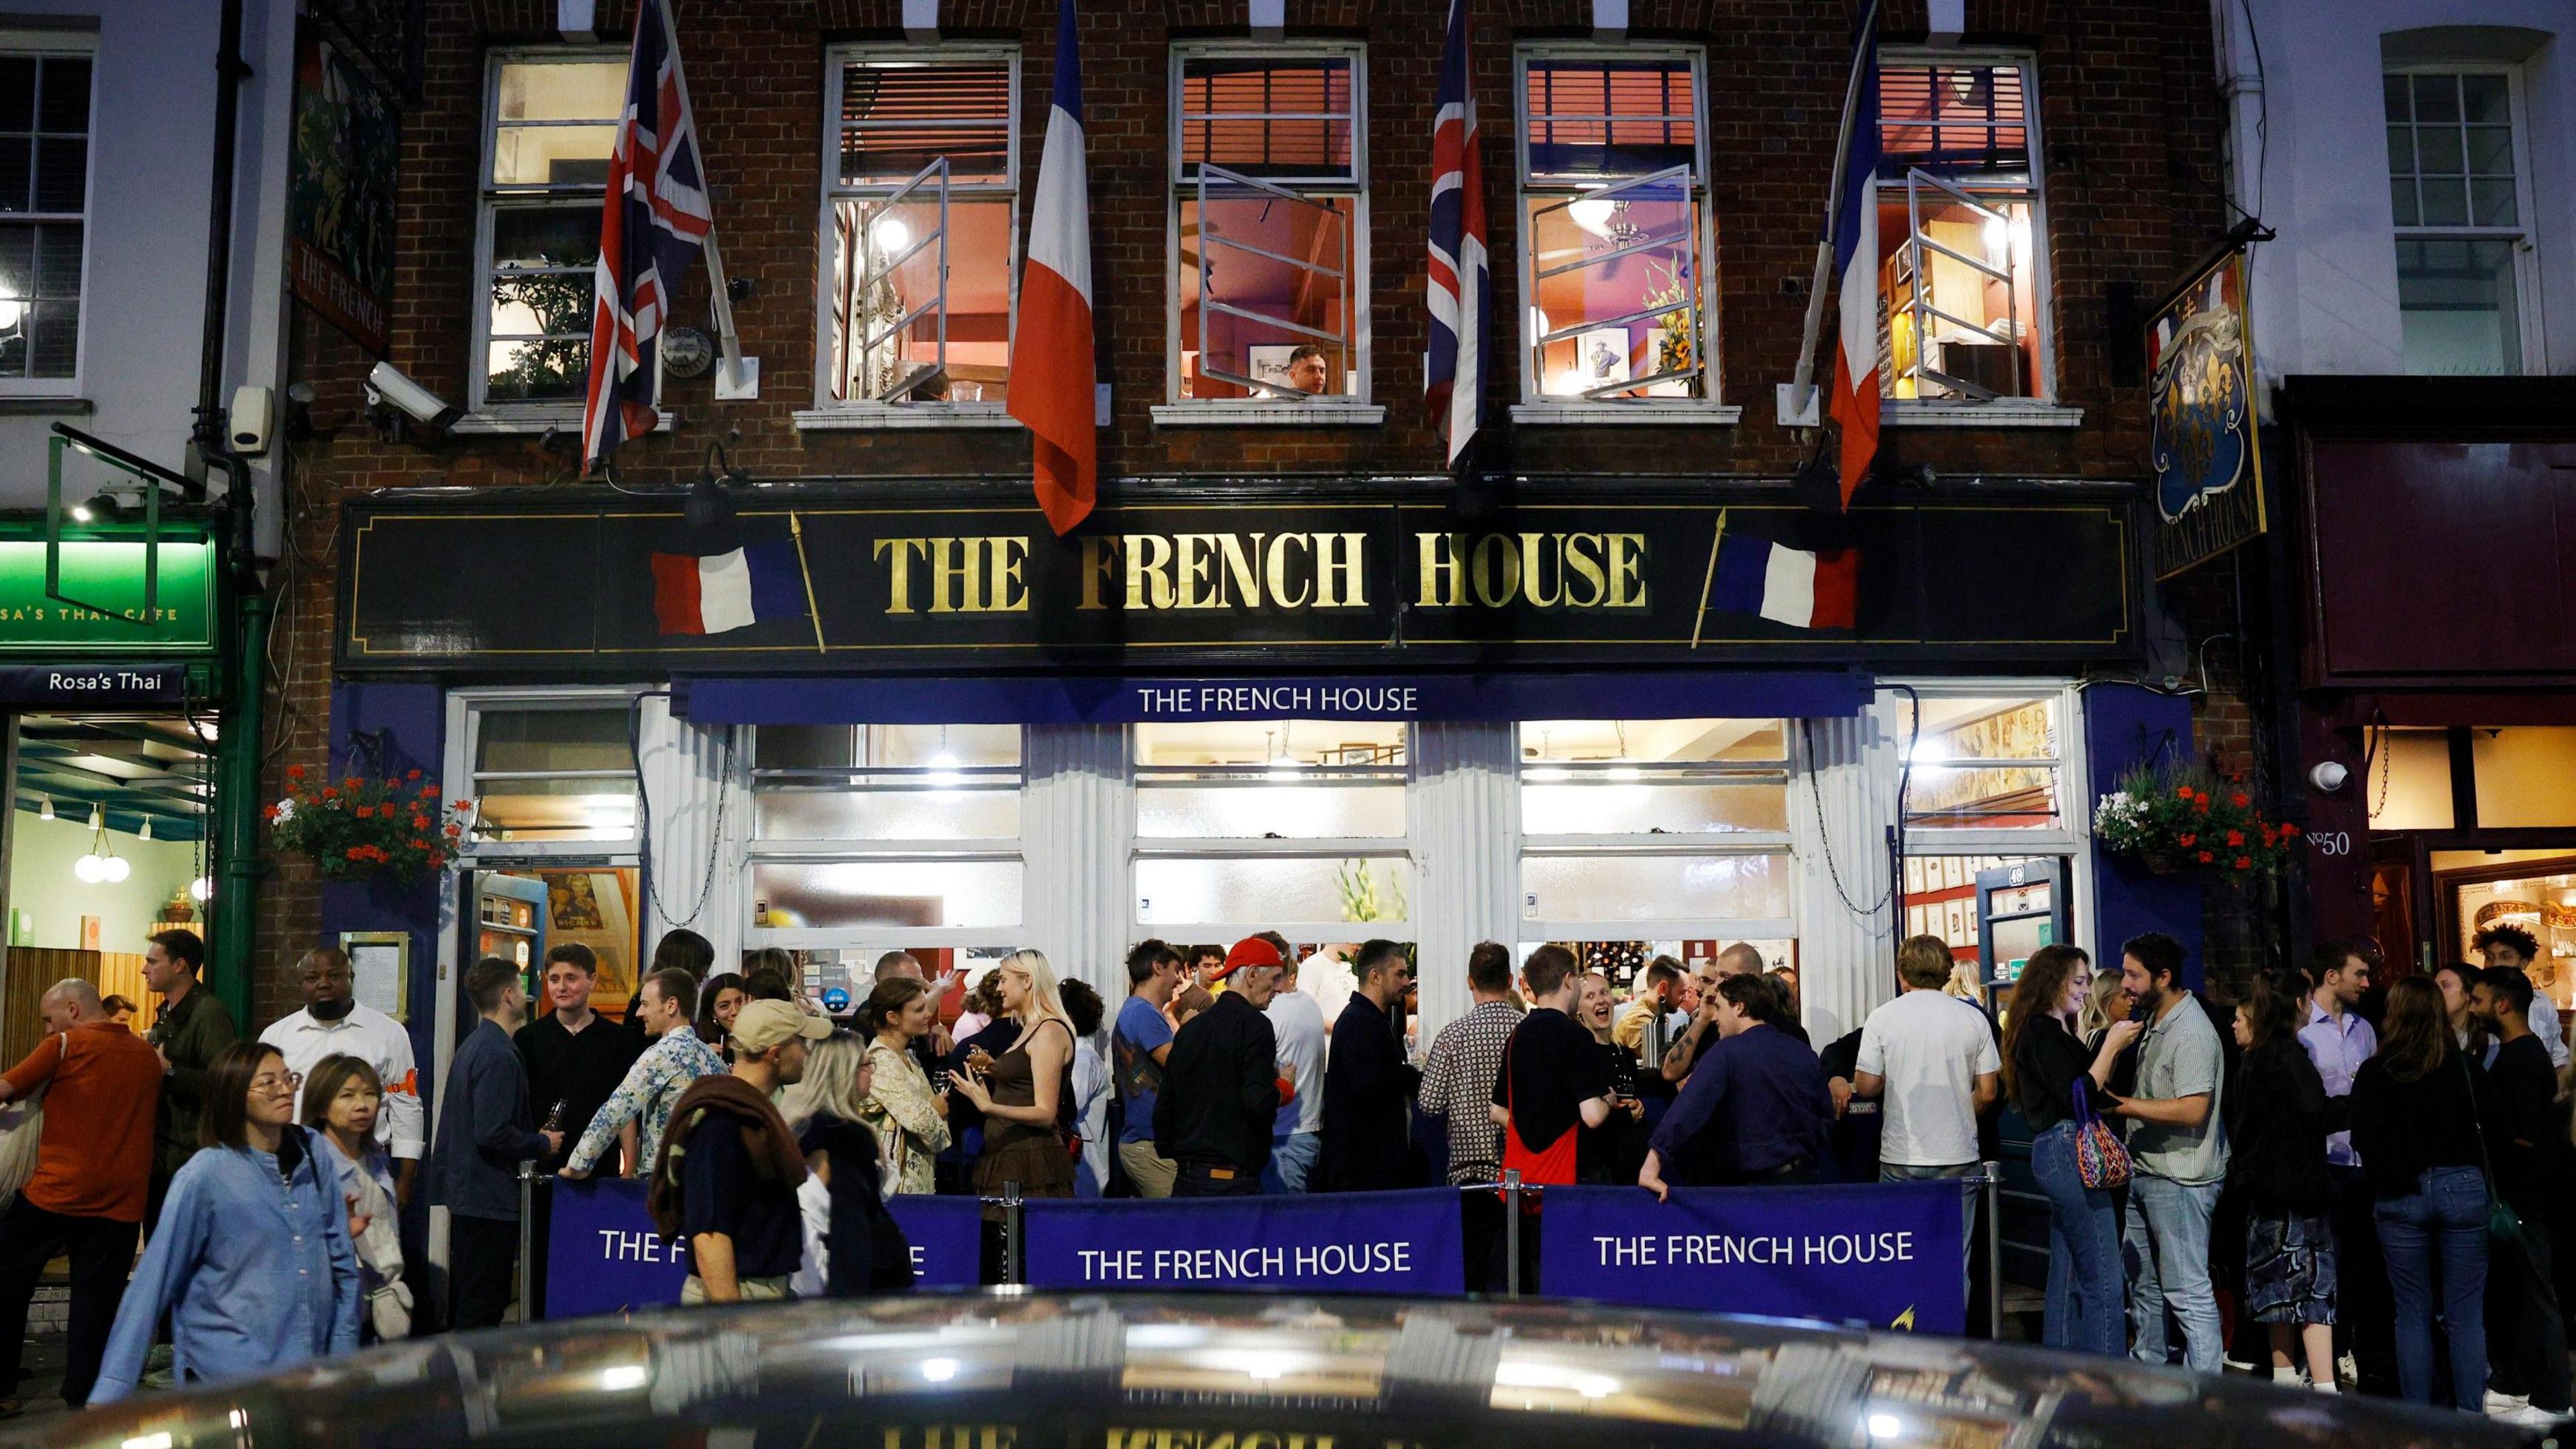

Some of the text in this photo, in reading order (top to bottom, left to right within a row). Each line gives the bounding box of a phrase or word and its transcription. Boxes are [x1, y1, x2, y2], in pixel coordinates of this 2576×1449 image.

[301, 244, 384, 338] THE FRENCH
[873, 533, 1646, 614] THE FRENCH HOUSE
[50, 672, 161, 690] Rosa's Thai
[1137, 687, 1417, 712] THE FRENCH HOUSE
[2011, 867, 2023, 883] 49
[598, 1230, 660, 1263] THE
[1077, 1242, 1411, 1280] THE FRENCH HOUSE
[1593, 1231, 1914, 1266] THE FRENCH HOUSE
